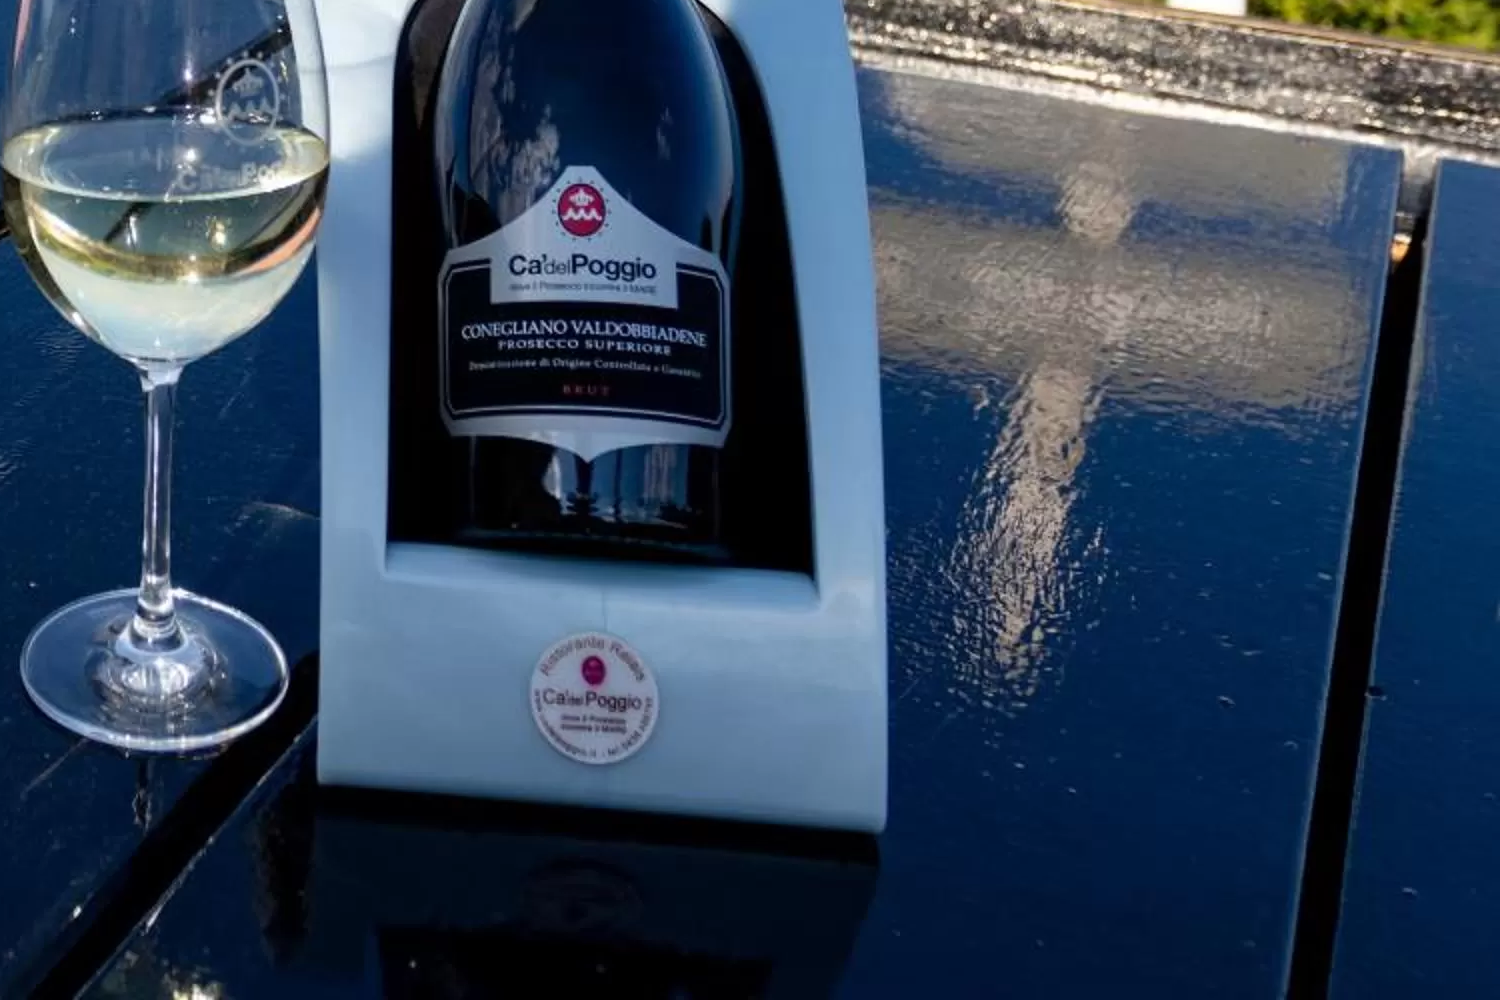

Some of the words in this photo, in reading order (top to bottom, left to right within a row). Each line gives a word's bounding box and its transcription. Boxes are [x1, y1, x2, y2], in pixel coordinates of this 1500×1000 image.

[461, 319, 568, 341] CONEGLIANO
[571, 319, 708, 347] VALDOBBIADENE
[498, 338, 579, 350] PROSECCO
[584, 339, 672, 356] SUPERIORE
[562, 384, 611, 397] BRUT
